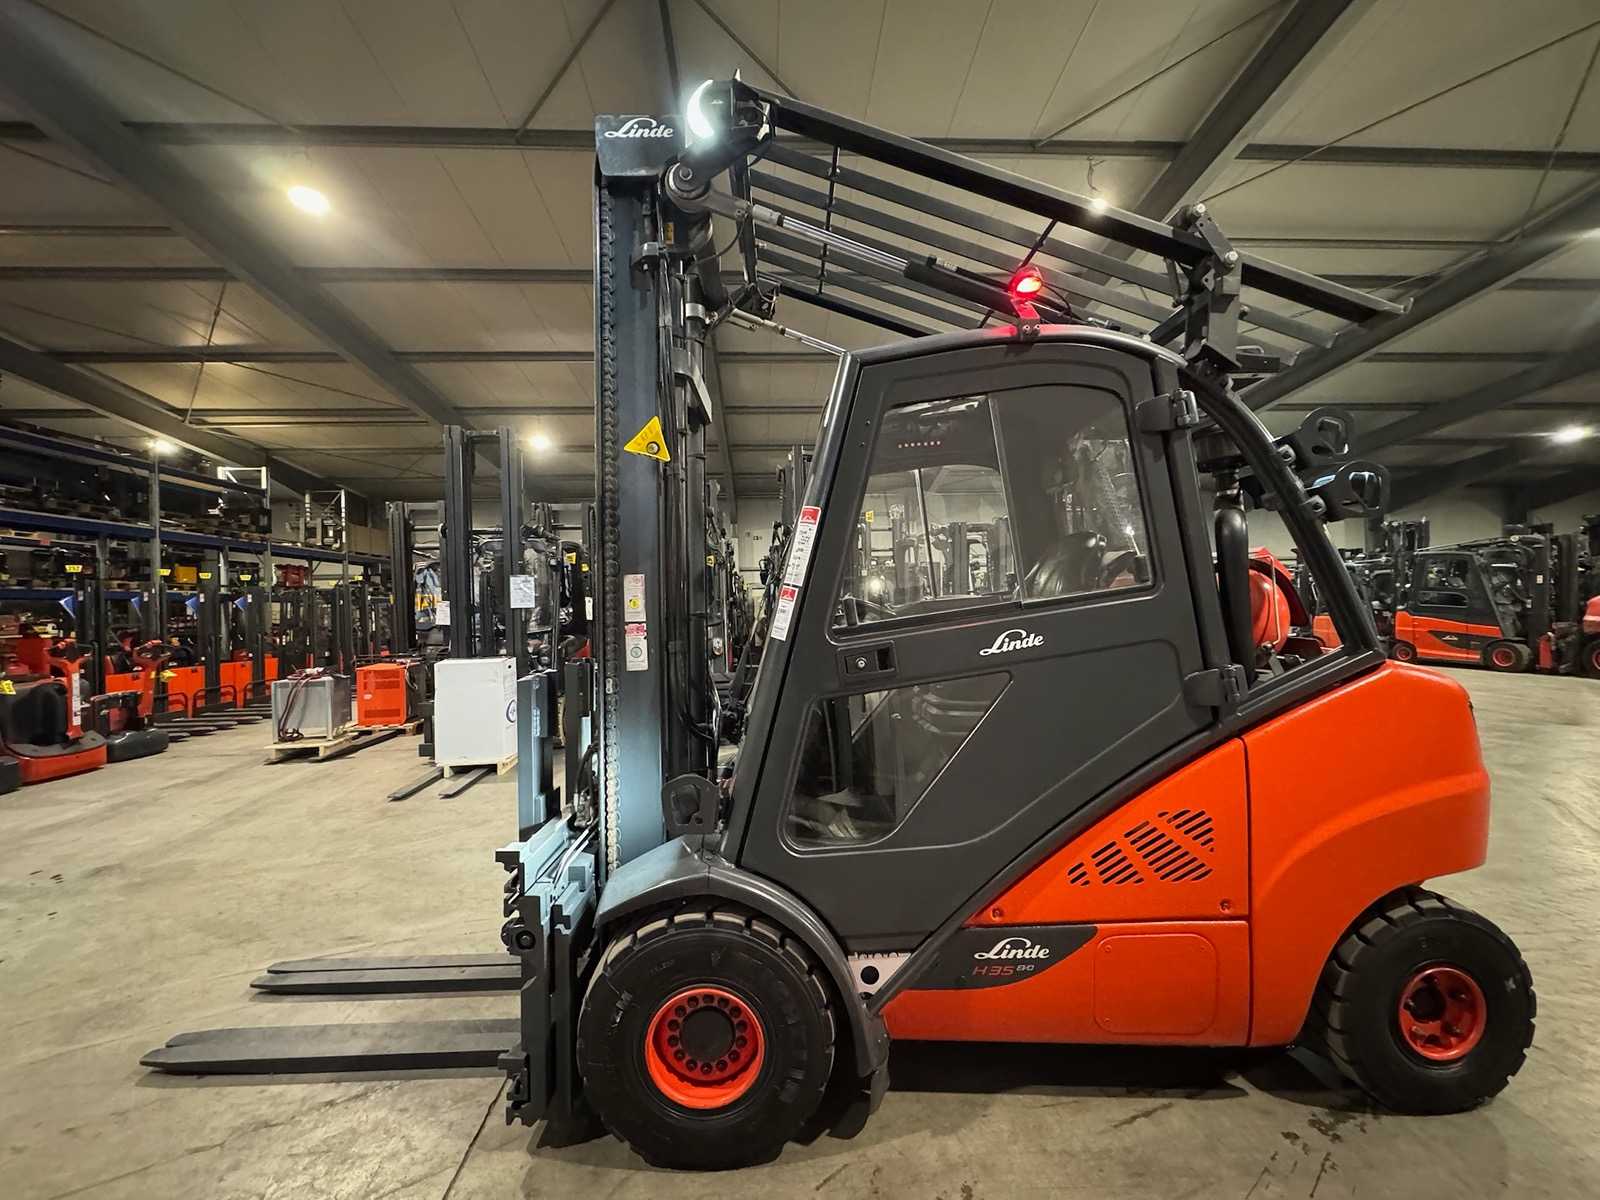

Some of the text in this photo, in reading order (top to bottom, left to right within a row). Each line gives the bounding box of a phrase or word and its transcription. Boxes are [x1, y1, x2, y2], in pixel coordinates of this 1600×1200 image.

[604, 117, 674, 138] Linde
[979, 629, 1045, 656] Linde
[973, 937, 1050, 960] Linde
